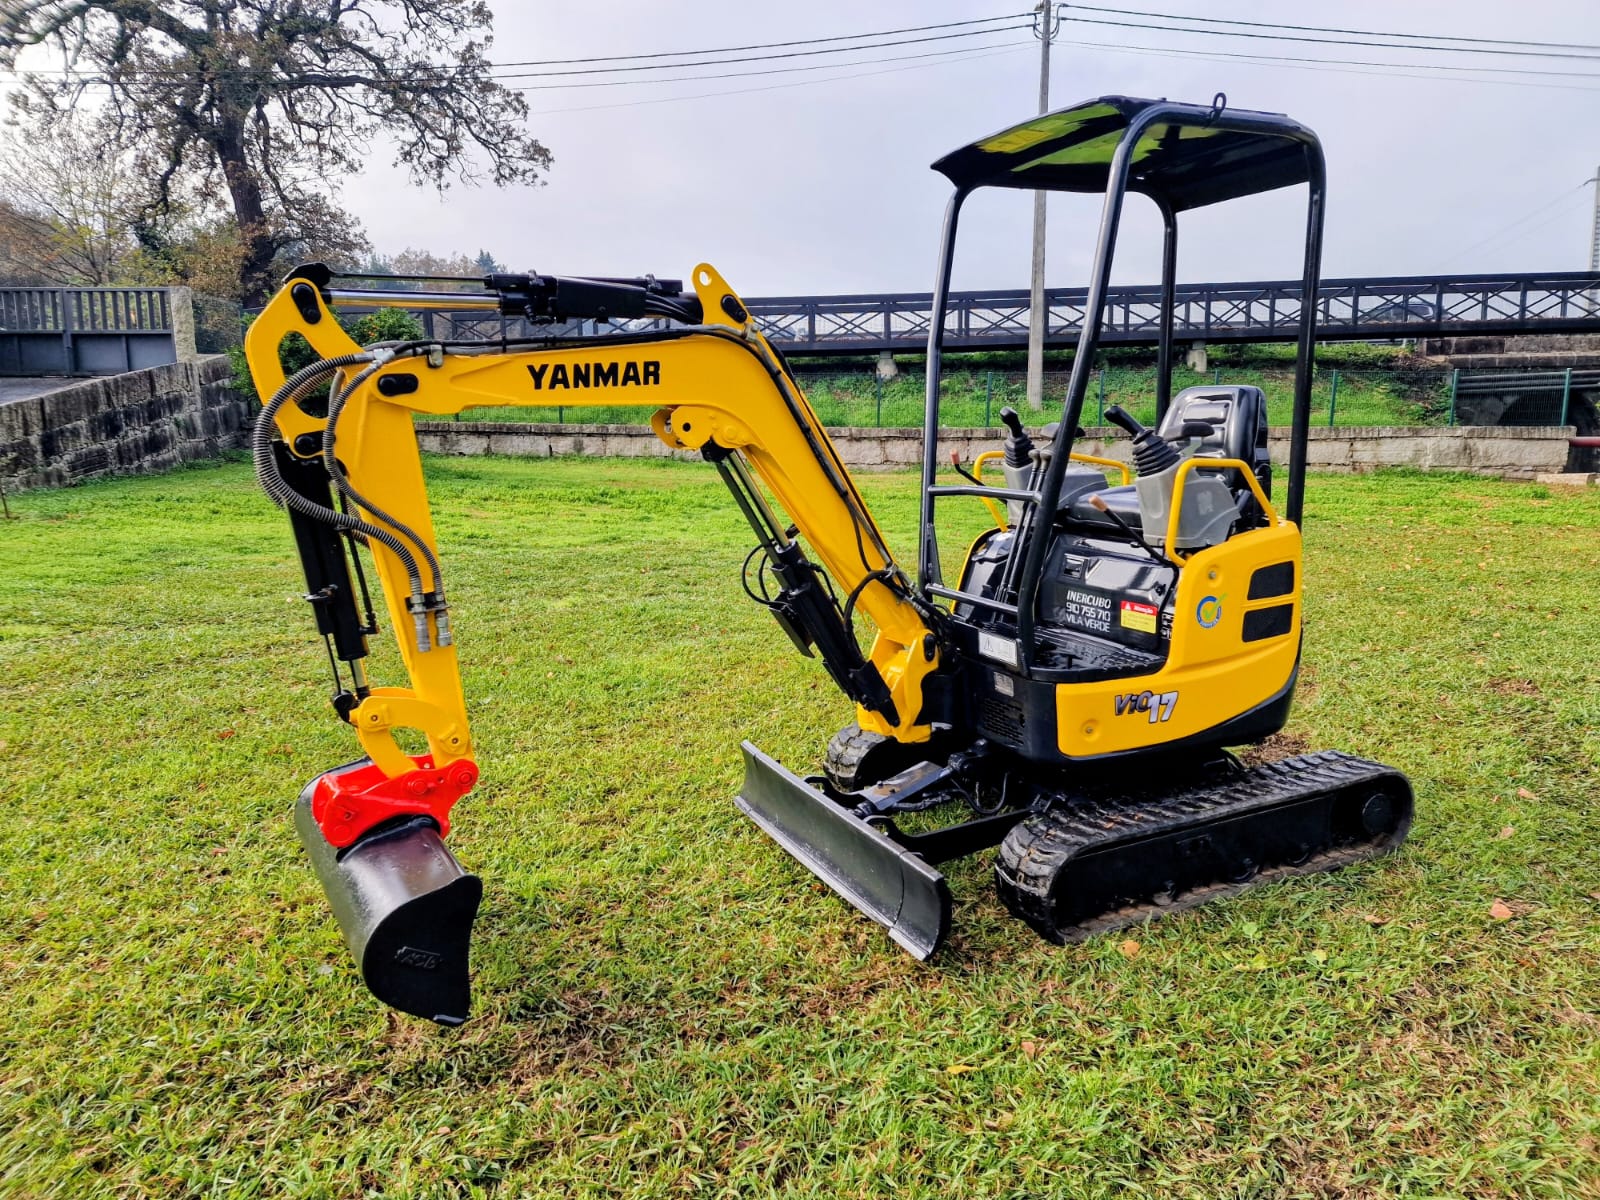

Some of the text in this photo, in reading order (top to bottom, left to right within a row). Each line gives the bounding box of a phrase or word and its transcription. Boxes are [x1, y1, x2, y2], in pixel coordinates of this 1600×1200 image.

[526, 361, 660, 390] YANMAR
[1066, 590, 1112, 609] INERCUBO
[1066, 602, 1080, 614] 910
[1081, 605, 1096, 618] 755
[1097, 609, 1111, 622] 710
[1066, 613, 1084, 625] VILA
[1085, 617, 1110, 632] VERDE
